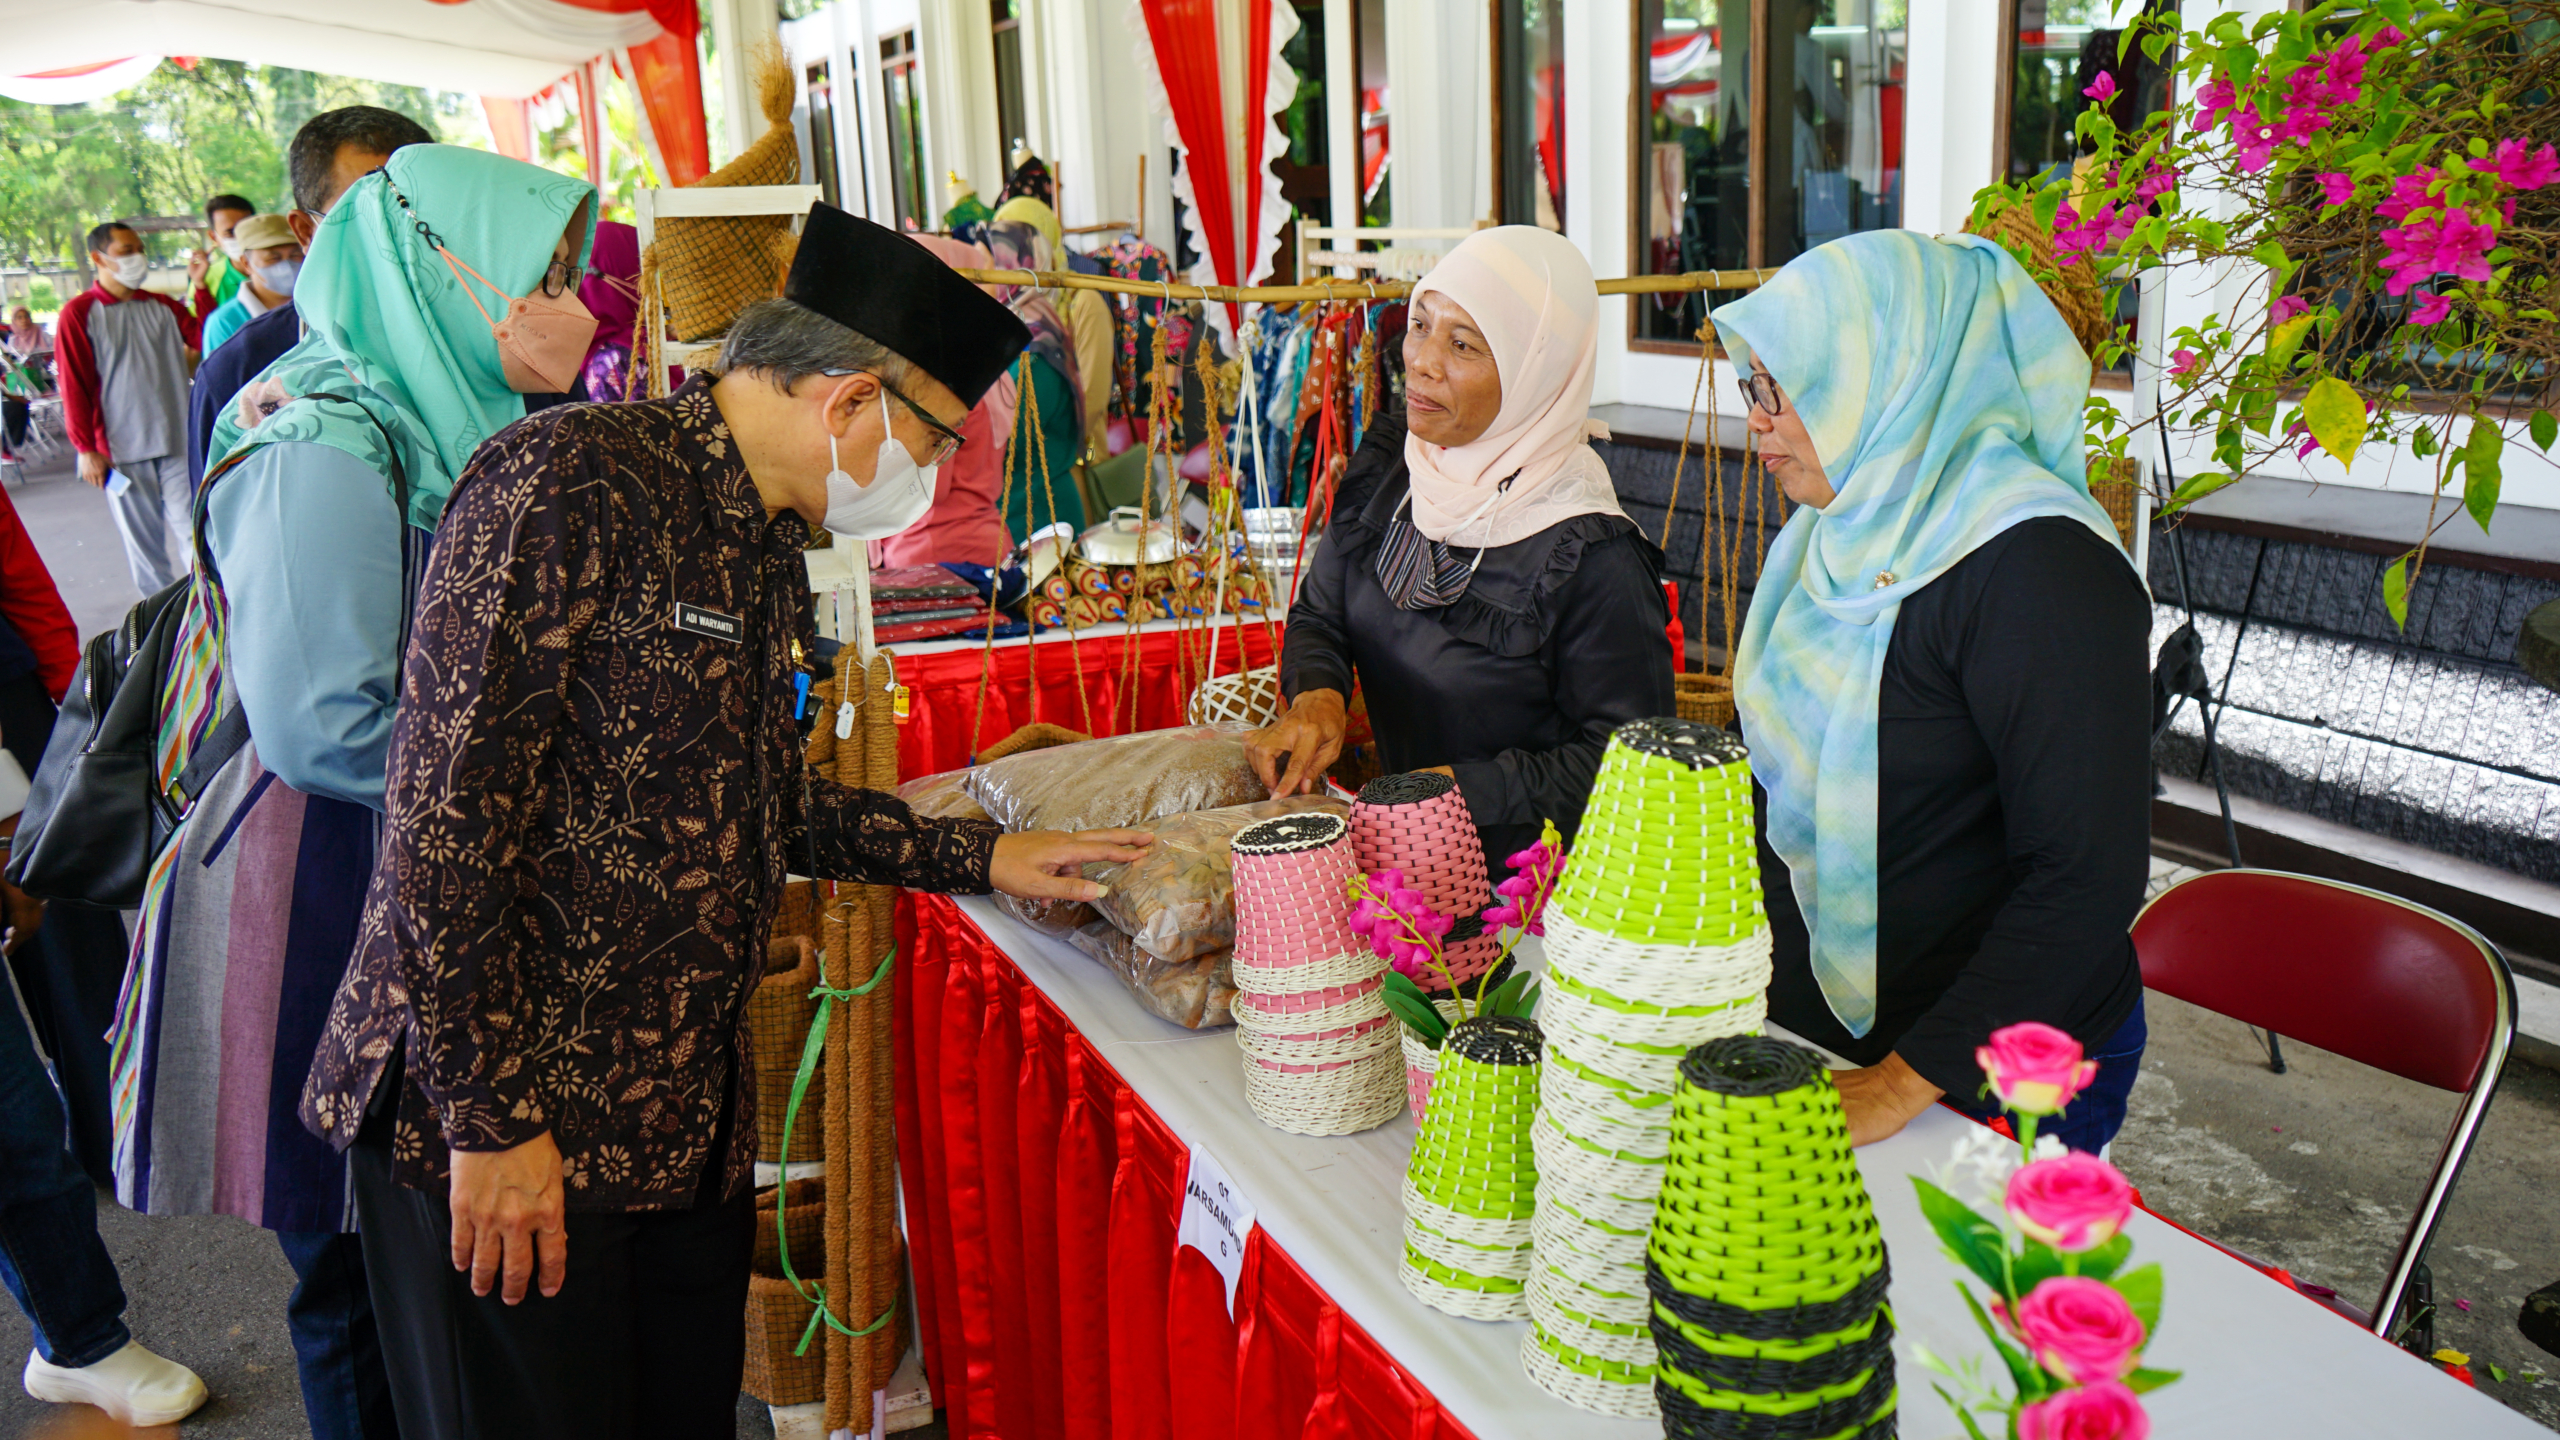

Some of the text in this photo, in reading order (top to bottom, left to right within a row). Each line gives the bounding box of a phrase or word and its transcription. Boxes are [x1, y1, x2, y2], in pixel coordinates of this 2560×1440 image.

[685, 611, 734, 634] ADI WARYANTO
[1220, 1239, 1228, 1258] G
